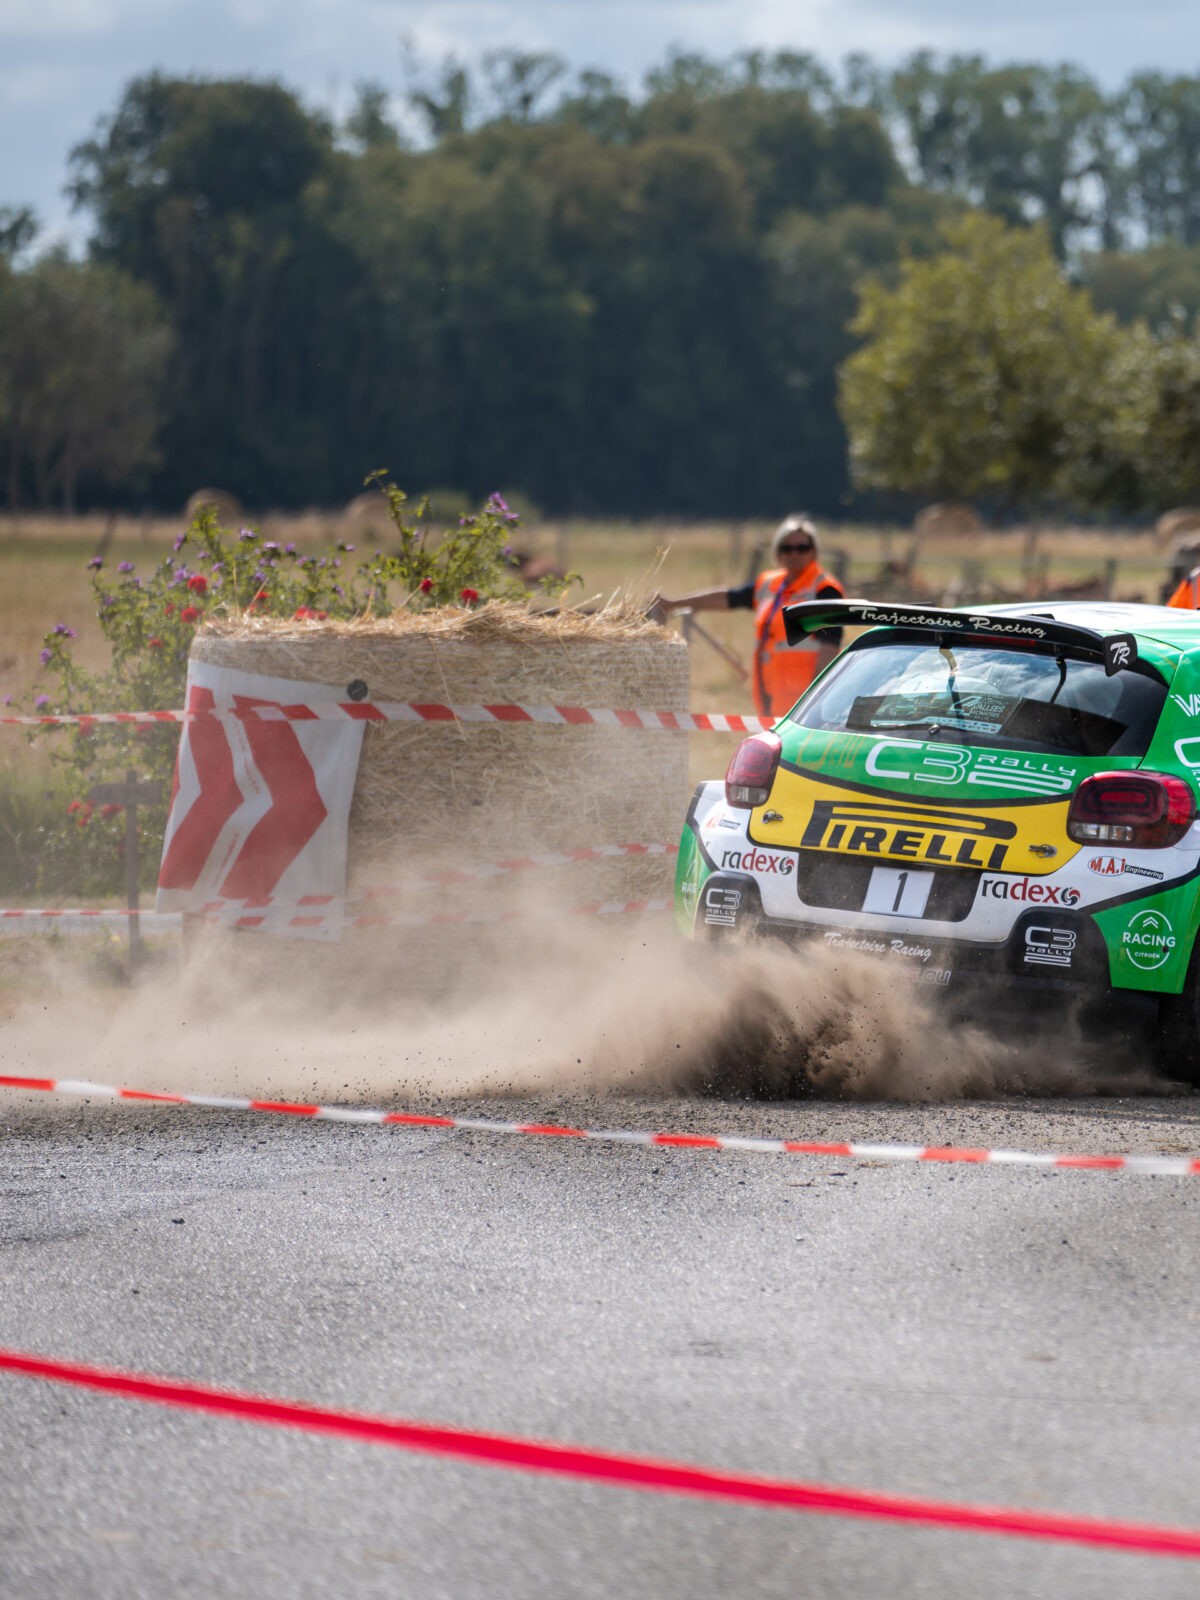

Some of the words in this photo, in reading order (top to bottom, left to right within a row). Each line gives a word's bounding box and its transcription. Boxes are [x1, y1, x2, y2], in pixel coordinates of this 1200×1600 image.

[849, 606, 963, 628] Trajectoire
[968, 616, 1047, 638] Racing
[1110, 641, 1131, 665] TR
[865, 740, 972, 785] C3
[800, 800, 1018, 870] PIRELLI
[1125, 865, 1164, 881] Engineering
[705, 888, 741, 910] C3
[892, 871, 909, 912] 1
[890, 939, 933, 961] Racing
[1025, 926, 1077, 951] C3
[1122, 932, 1176, 948] RACING
[1134, 951, 1161, 960] CITROËN
